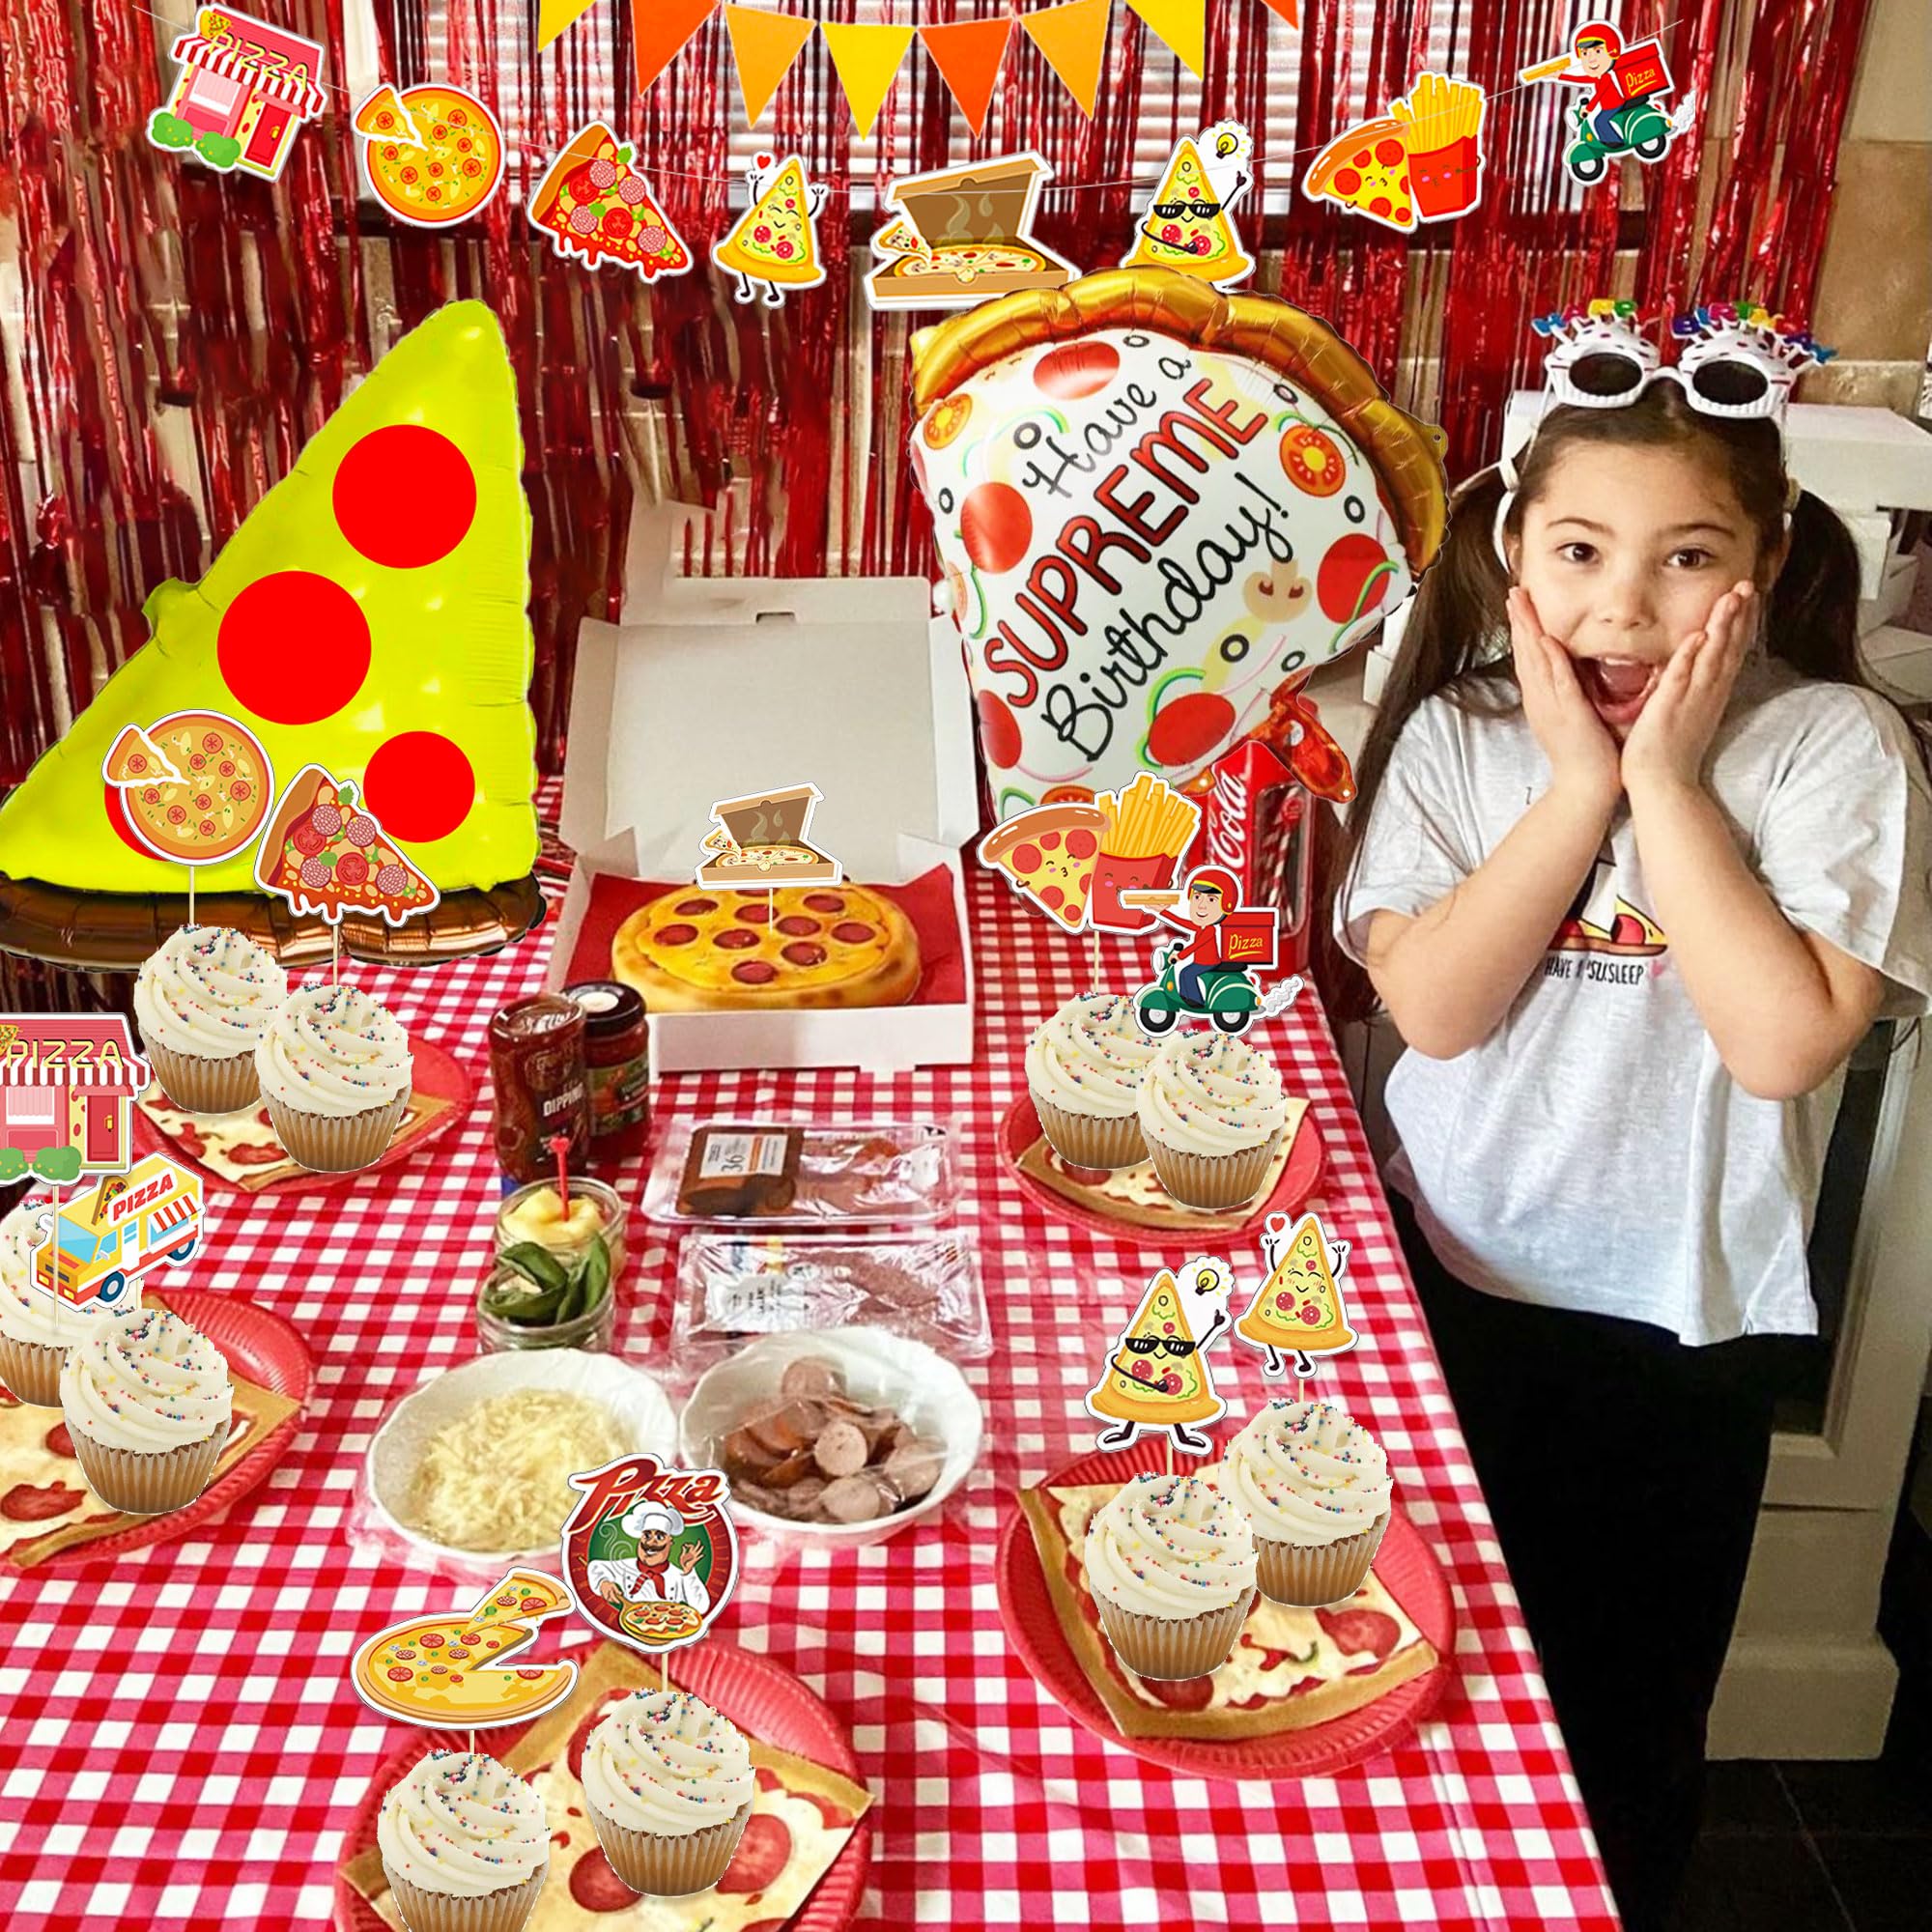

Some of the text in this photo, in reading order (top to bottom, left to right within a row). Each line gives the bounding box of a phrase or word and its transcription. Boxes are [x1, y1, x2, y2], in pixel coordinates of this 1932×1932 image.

[208, 33, 309, 90] PIZZA
[1022, 355, 1192, 497] Have a
[983, 378, 1268, 709] SUPREME
[1041, 472, 1293, 761] Birthday!
[1208, 769, 1247, 868] Cola
[1228, 933, 1264, 959] Pizza
[6, 1039, 125, 1069] PIZZA
[112, 1174, 174, 1222] PIZZA
[568, 1459, 724, 1534] Pizza
